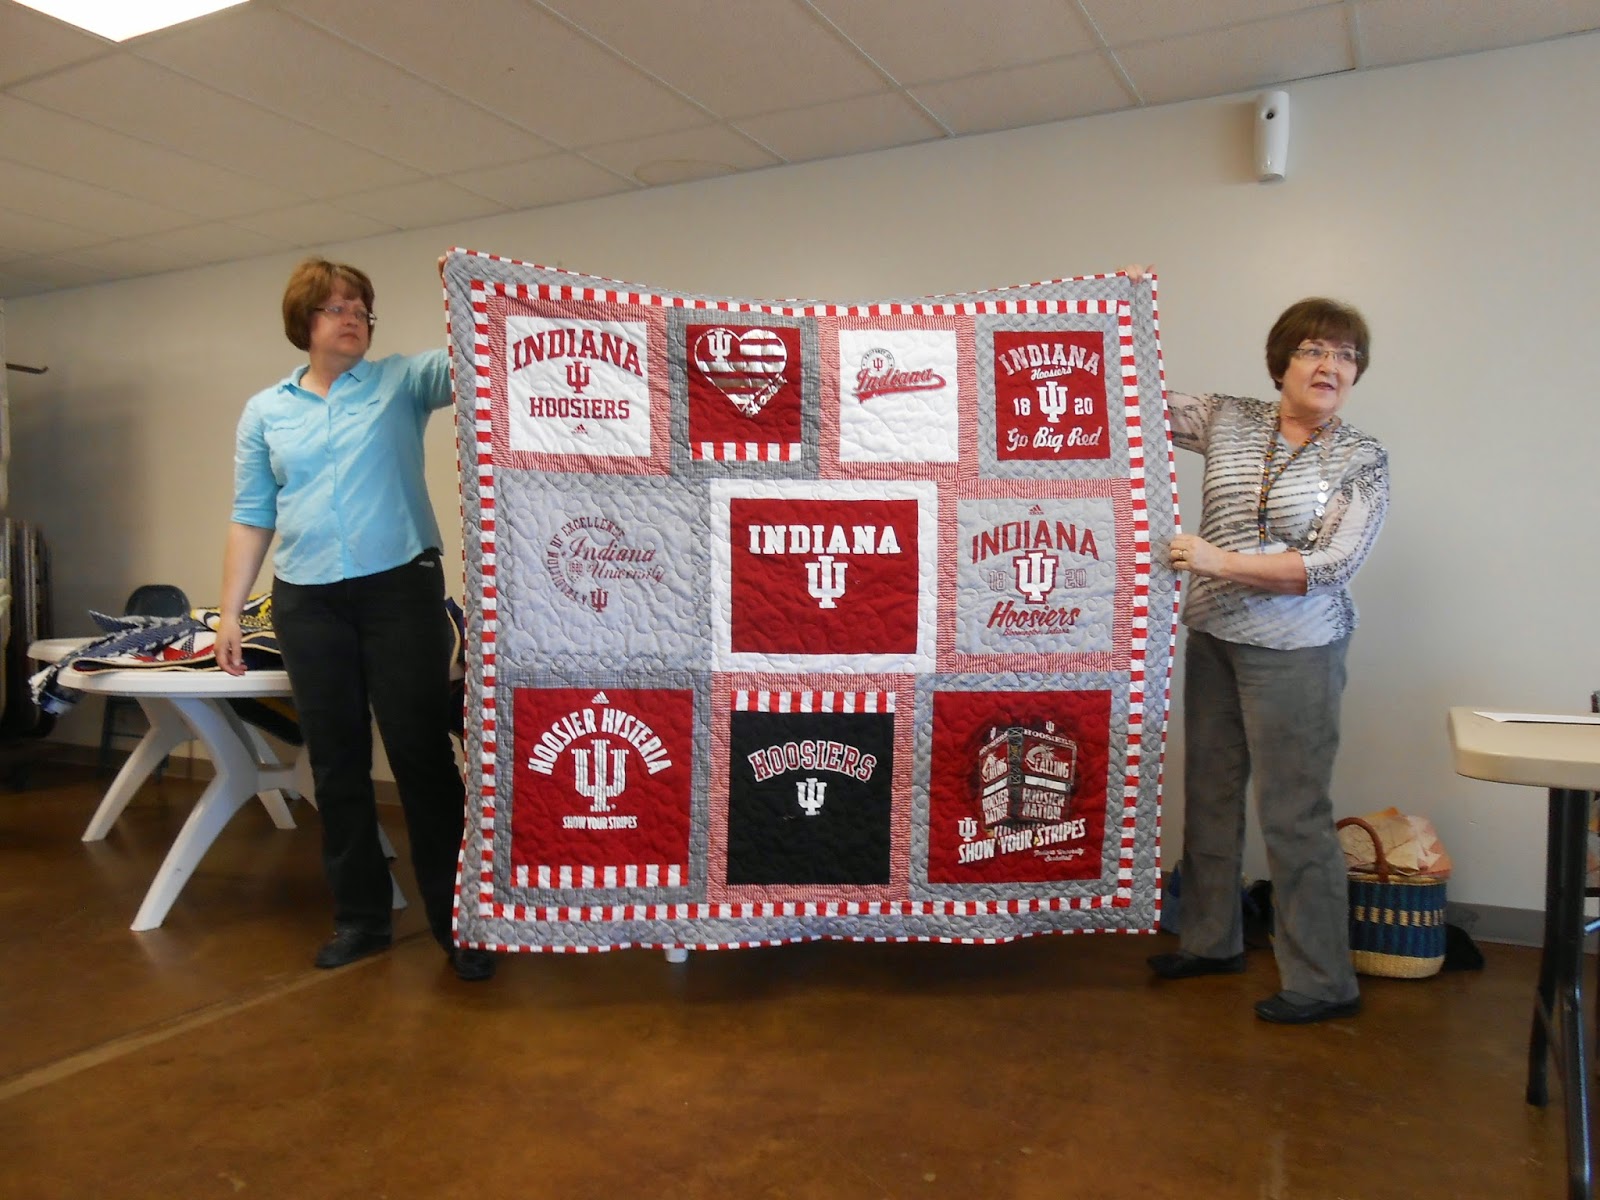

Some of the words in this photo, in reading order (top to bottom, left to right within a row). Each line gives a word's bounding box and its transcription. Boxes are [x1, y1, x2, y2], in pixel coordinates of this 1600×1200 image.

[512, 328, 643, 376] INDIANA
[998, 344, 1100, 377] INDIANA
[853, 368, 933, 391] Indiana
[1031, 366, 1072, 381] Hoosiers
[529, 397, 630, 419] HOOSIERS
[1013, 398, 1031, 416] 18
[1074, 397, 1094, 415] 20
[1006, 426, 1029, 451] Go
[1033, 427, 1063, 452] Big
[1069, 426, 1103, 446] Red
[569, 536, 657, 563] Indiana
[749, 525, 902, 554] INDIANA
[972, 520, 1100, 564] INDIANA
[587, 560, 665, 586] University
[1064, 568, 1087, 589] 20
[987, 601, 1081, 629] Hoosiers
[528, 708, 597, 776] HOOSIER
[601, 708, 673, 775] HYSTERIA
[748, 740, 877, 783] HOOSIERS
[1022, 788, 1066, 807] HOOSIER
[562, 815, 587, 829] SHOW
[1022, 803, 1061, 820] NATION
[957, 838, 996, 864] SHOW
[1000, 829, 1033, 855] YOUR
[1035, 818, 1087, 847] STRIPES
